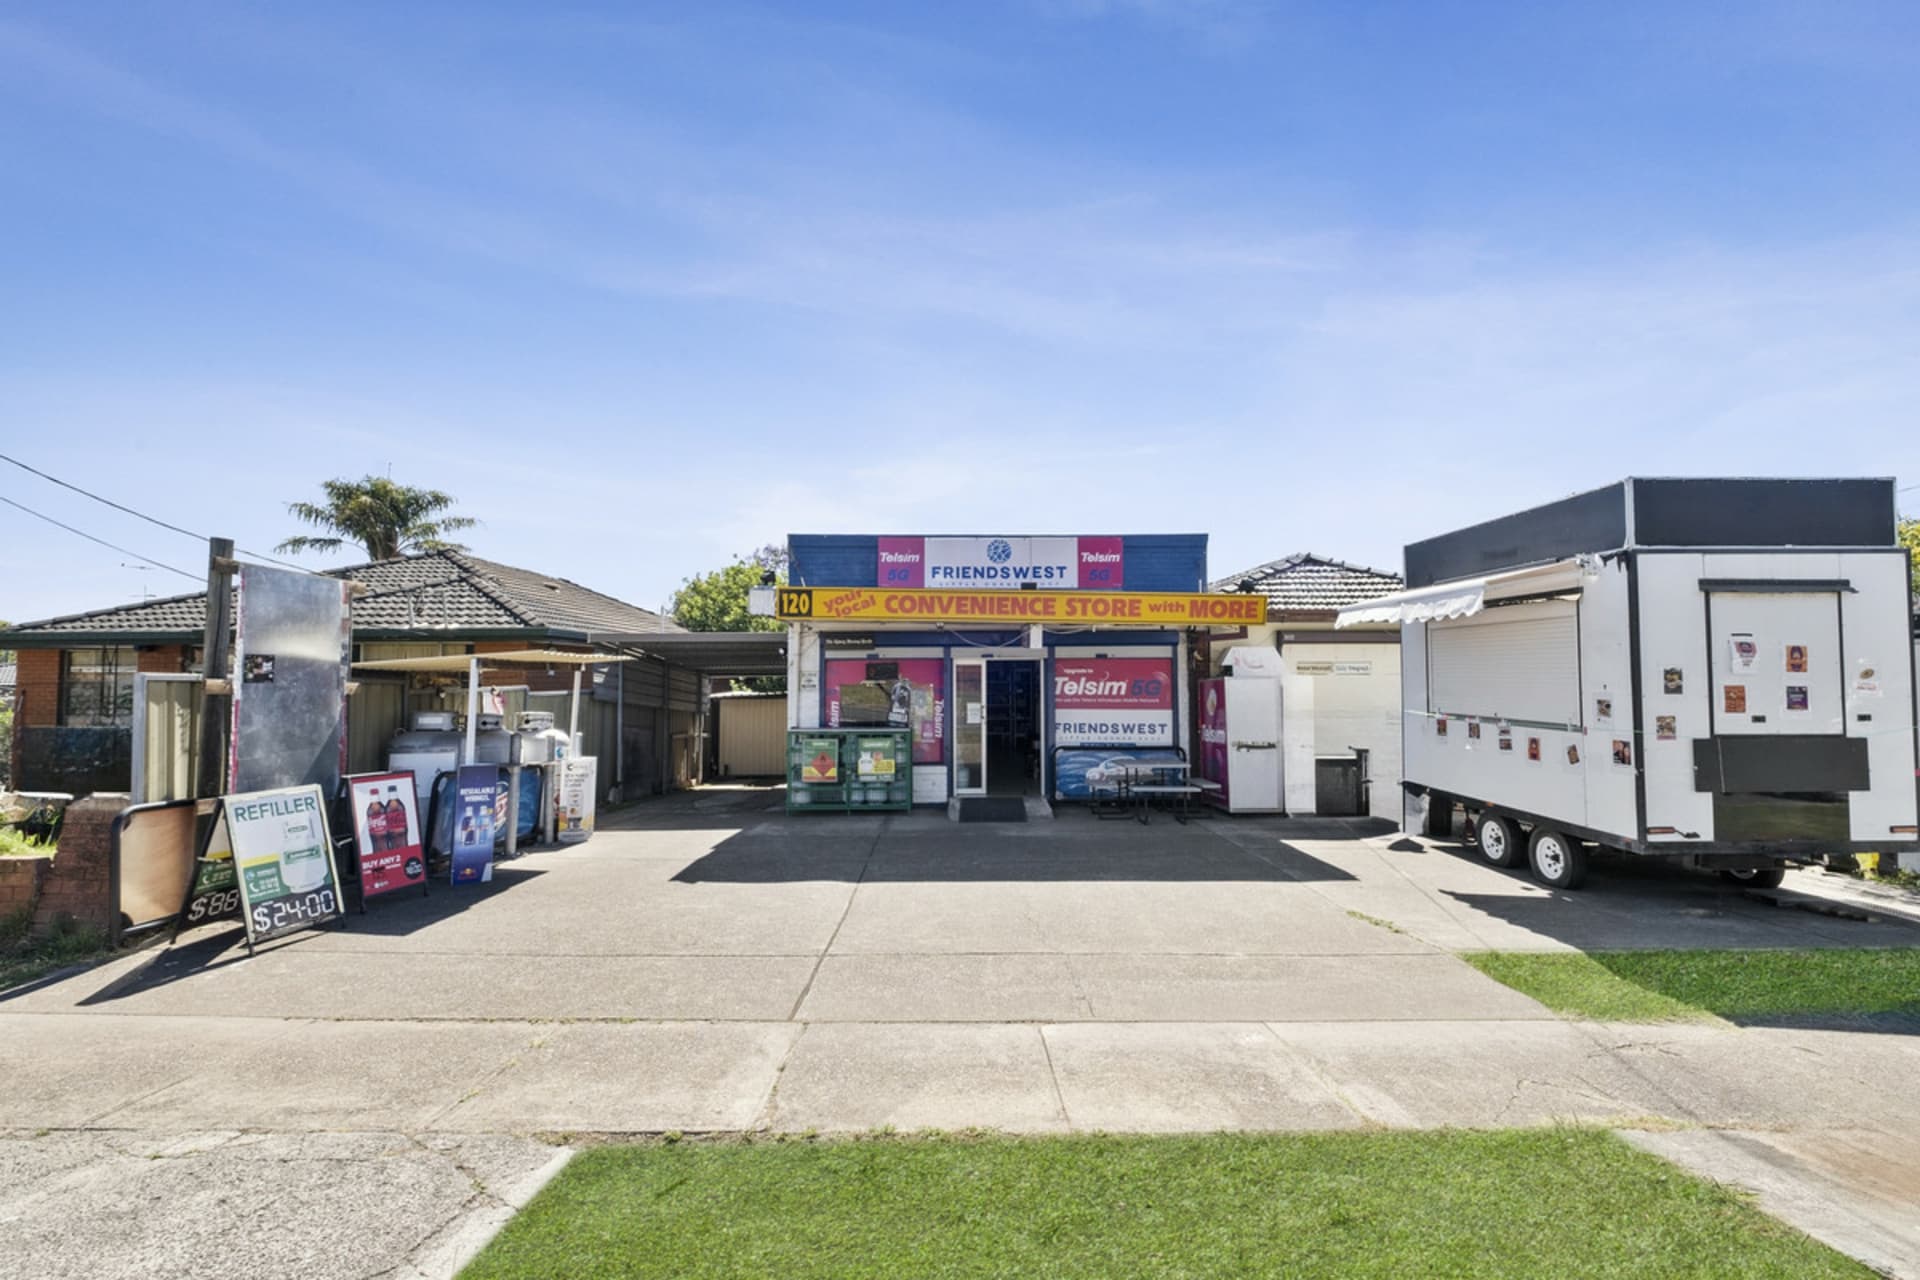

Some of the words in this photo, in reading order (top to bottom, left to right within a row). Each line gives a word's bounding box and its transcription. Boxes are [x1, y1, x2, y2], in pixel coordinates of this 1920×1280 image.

[880, 551, 920, 563] Telsim
[1081, 551, 1121, 562] Telsim
[887, 568, 910, 580] 5G
[931, 566, 1067, 579] FRIENDSWEST
[1089, 568, 1110, 580] 5G
[782, 592, 810, 614] 120
[823, 590, 862, 612] your
[834, 594, 876, 617] local
[885, 595, 1057, 616] CONVENIENCE
[1065, 597, 1142, 617] STORE
[1148, 600, 1185, 613] with
[1190, 598, 1259, 618] MORE
[1055, 674, 1127, 696] Telsim
[1131, 679, 1162, 697] 5G
[1055, 722, 1168, 734] FRIENDSWEST
[234, 796, 316, 822] REFILLER
[362, 857, 378, 870] BUY
[379, 855, 396, 866] ANY
